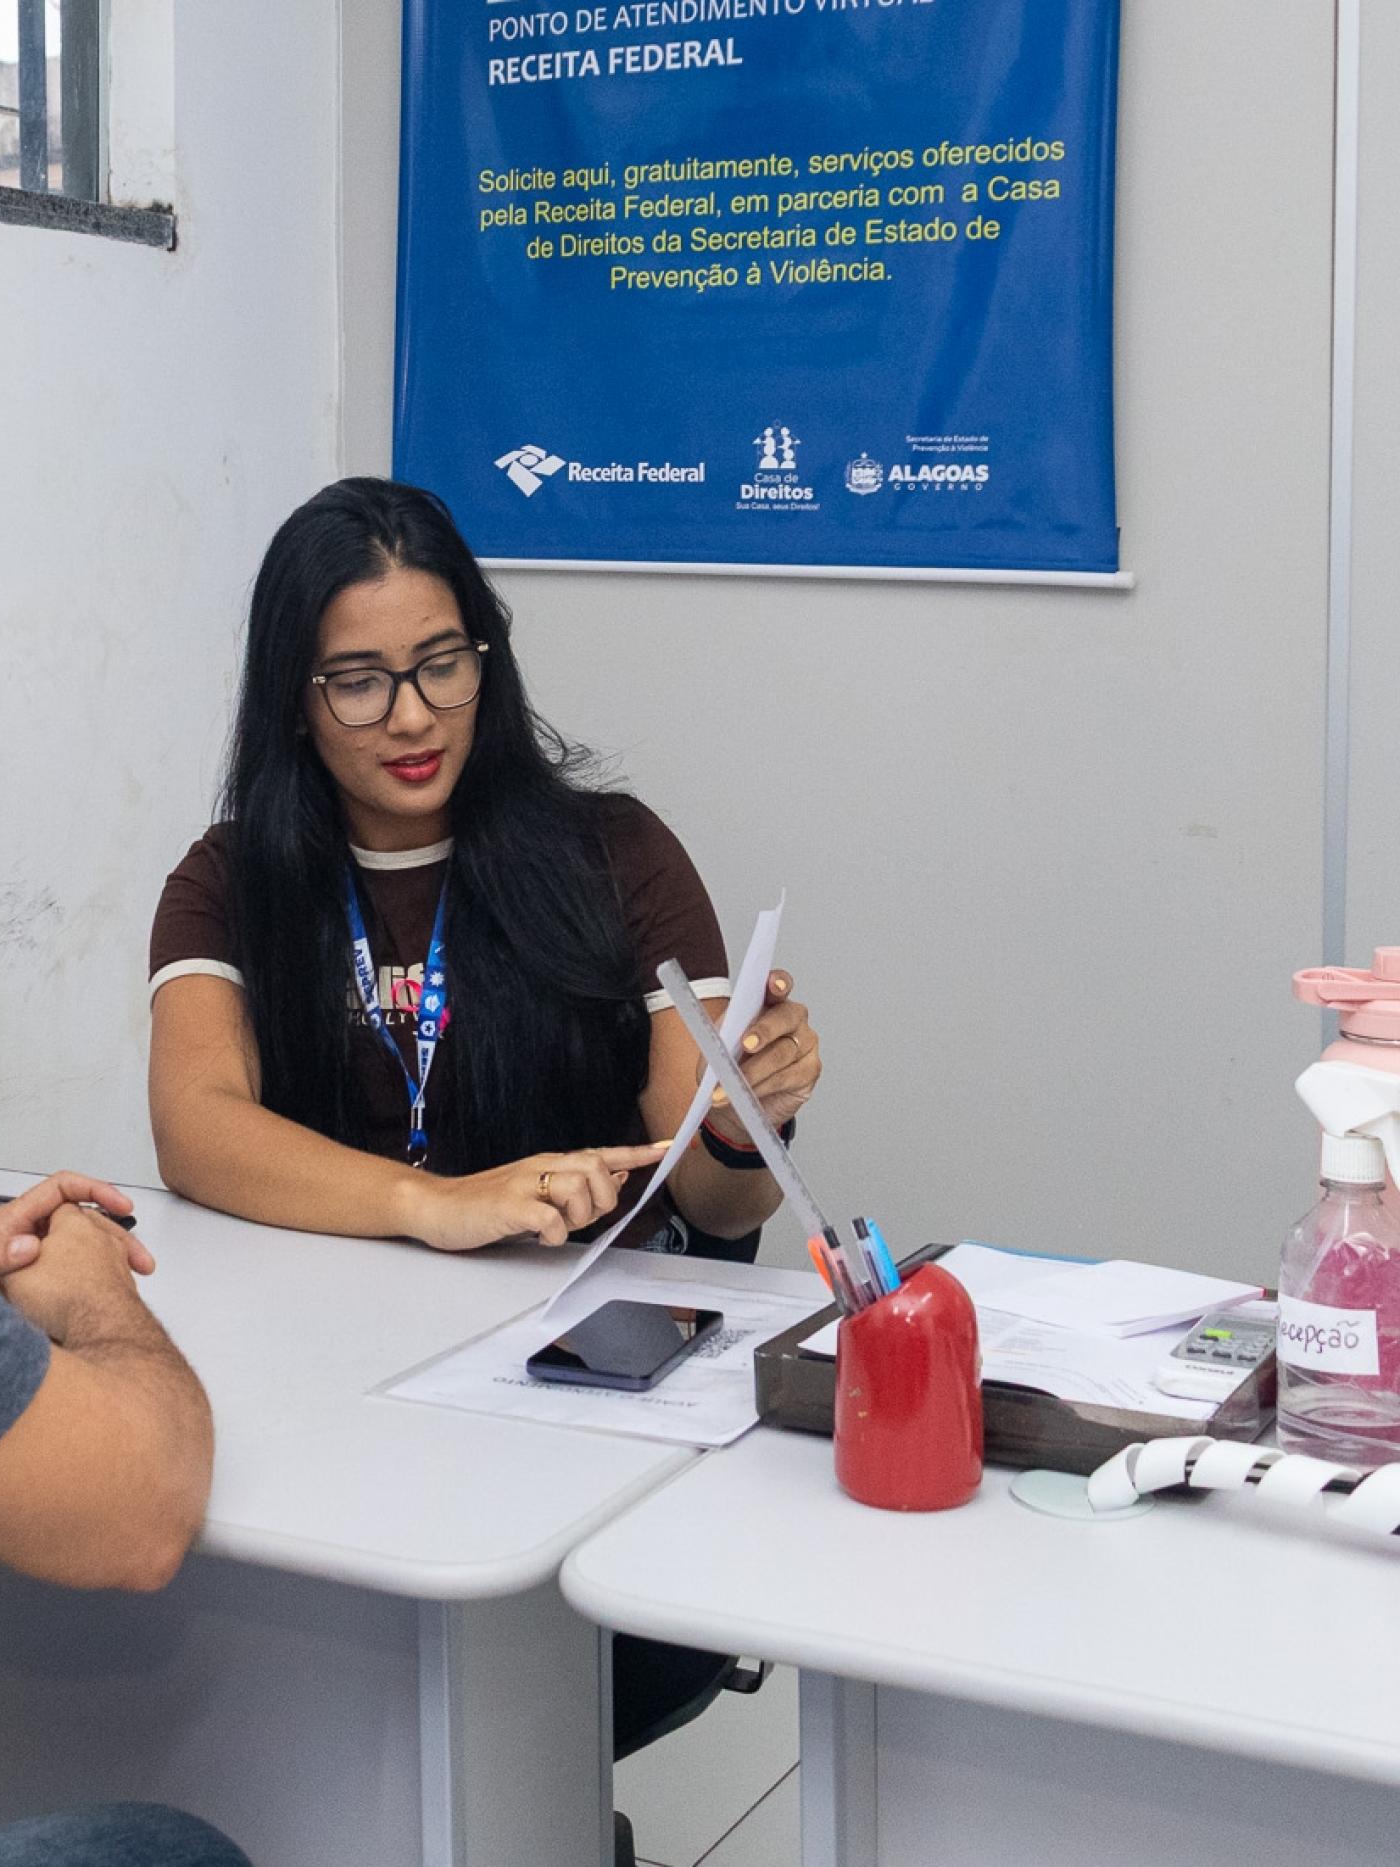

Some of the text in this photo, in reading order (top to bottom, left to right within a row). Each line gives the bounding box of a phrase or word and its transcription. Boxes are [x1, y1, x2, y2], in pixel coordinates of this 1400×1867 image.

[489, 0, 805, 42] PONTO DE ATENDIMENTO
[488, 37, 743, 86] RECEITA FEDERAL
[478, 136, 1065, 193] Solicite aqui, gratuitamente, serviços oferecidos
[480, 175, 1060, 232] pela Receita Federal, em parceria com a Casa
[526, 214, 1001, 259] de Direitos da Secretaria de Estado de
[610, 257, 892, 293] Prevenção à Violência.
[567, 462, 706, 483] Receita Federal
[753, 473, 799, 484] Casa de
[888, 464, 989, 482] ALAGOAS
[894, 483, 983, 491] GOVERNO
[740, 484, 814, 500] Direitos
[1279, 1320, 1362, 1354] ecepção
